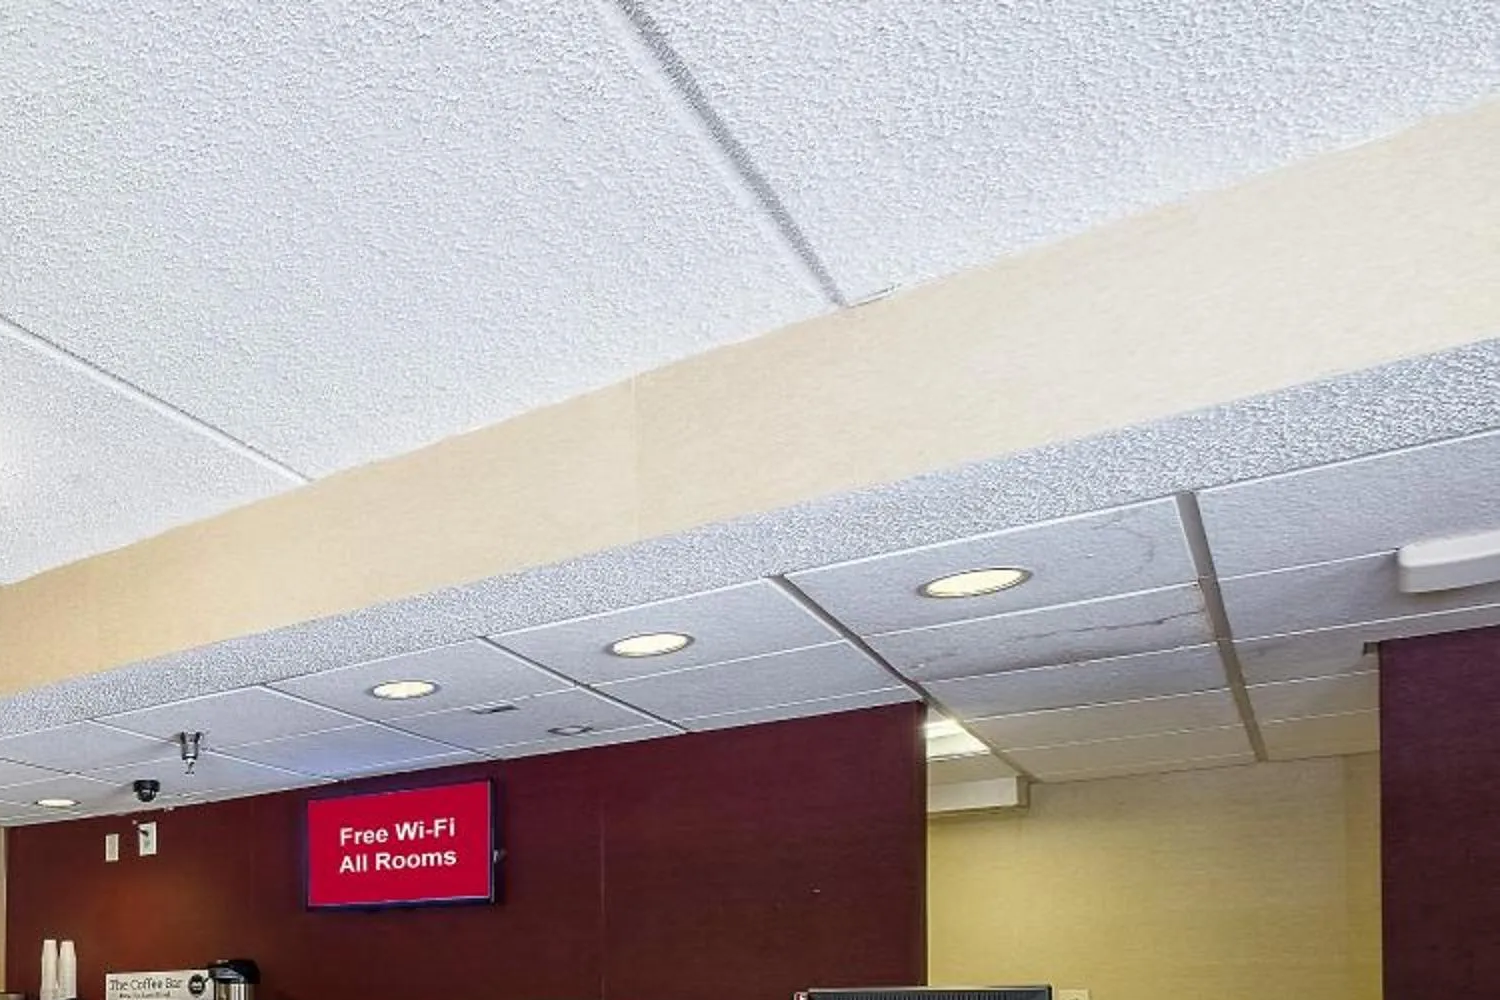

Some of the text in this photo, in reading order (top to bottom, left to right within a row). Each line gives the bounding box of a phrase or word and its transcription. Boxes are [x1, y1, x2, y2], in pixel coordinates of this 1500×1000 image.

[339, 817, 456, 846] Free Wi-Fi
[339, 850, 457, 874] All Rooms
[109, 979, 128, 991] The
[130, 977, 162, 990] Coffee
[165, 977, 183, 989] Bar
